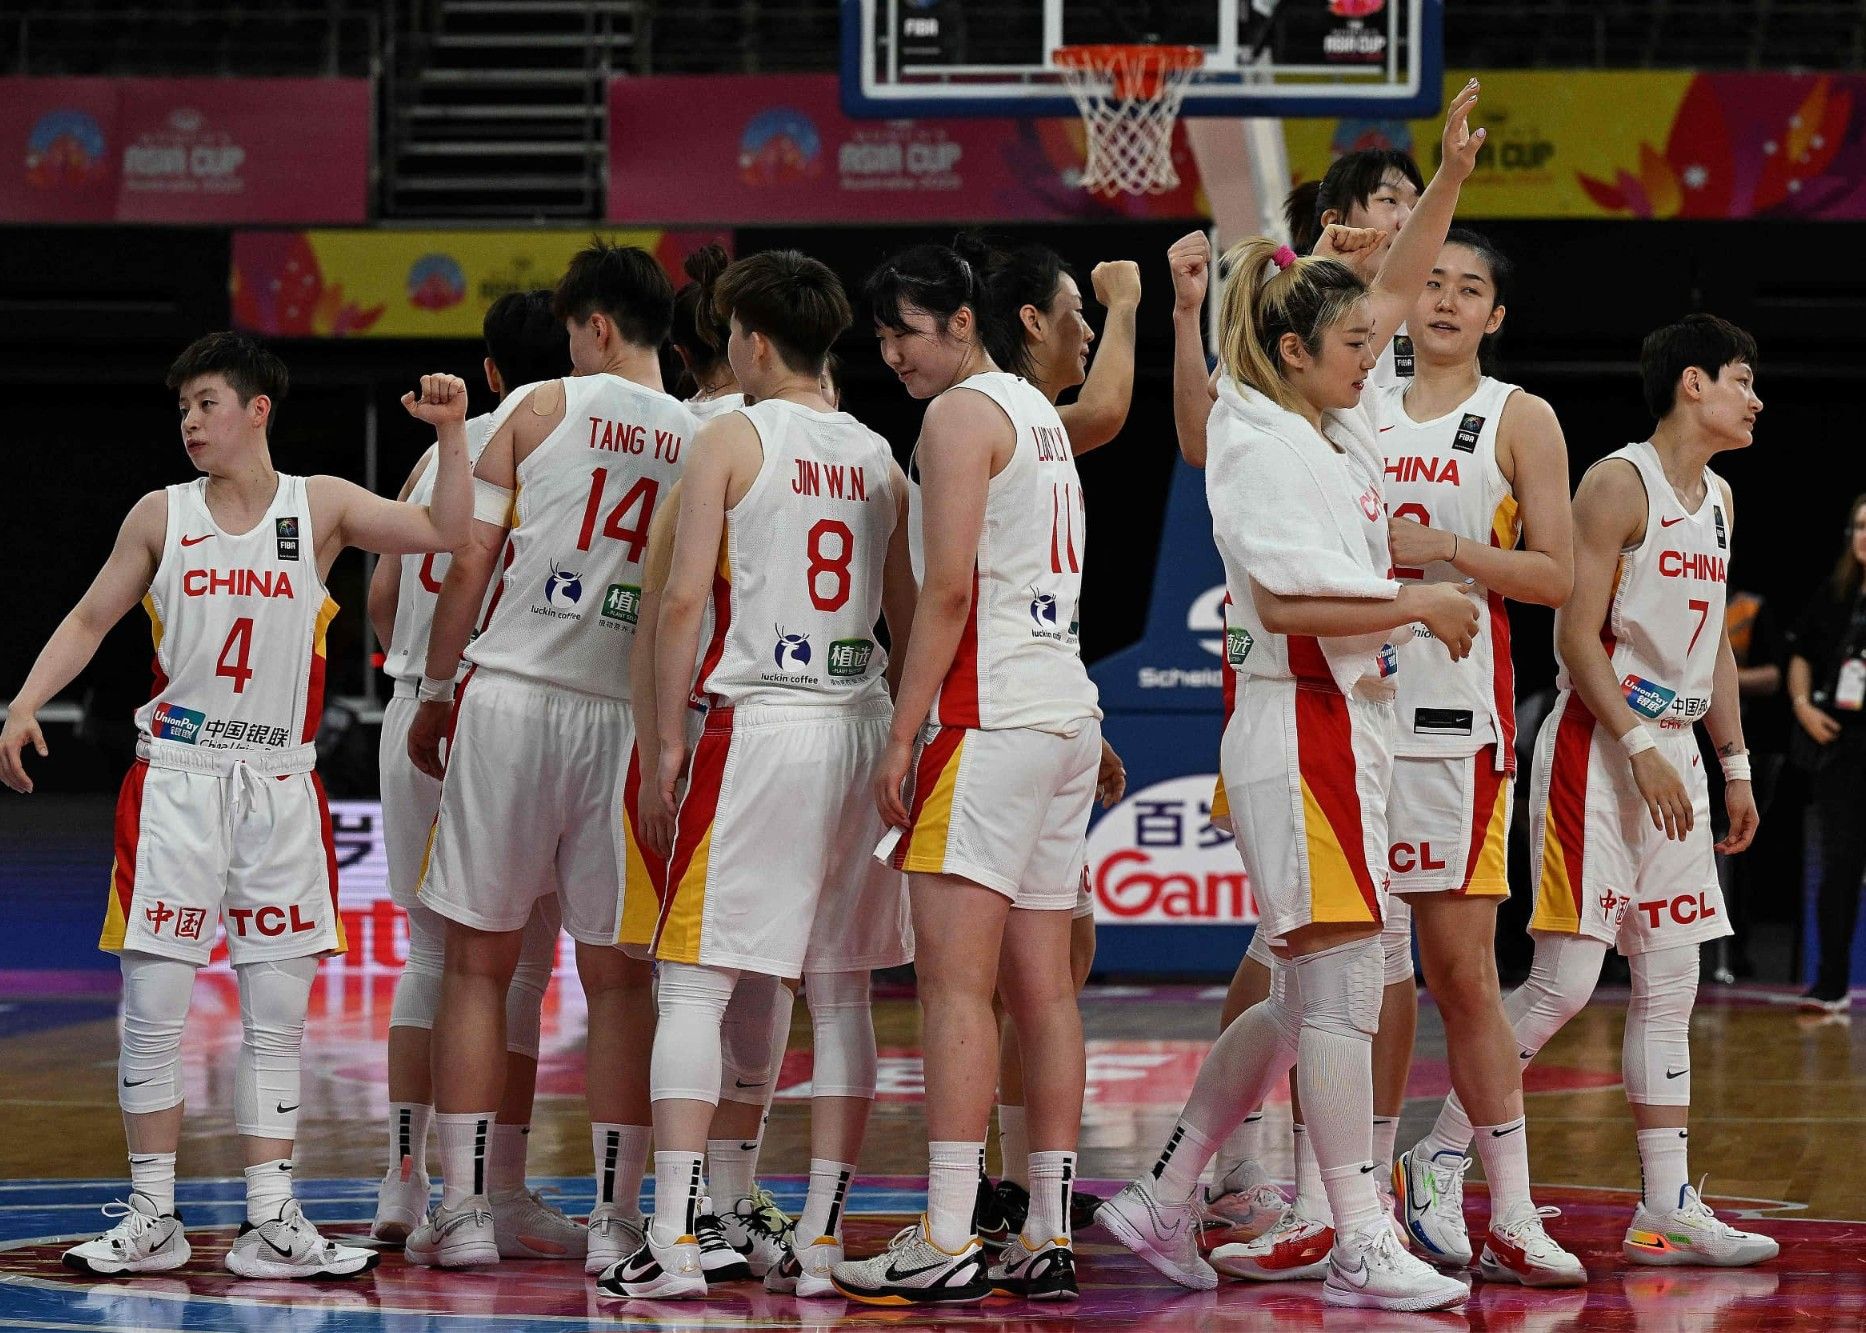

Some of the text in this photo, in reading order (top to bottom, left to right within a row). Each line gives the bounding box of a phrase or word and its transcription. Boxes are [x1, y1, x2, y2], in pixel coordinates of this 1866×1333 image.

[191, 145, 246, 177] CUP
[907, 142, 963, 175] CUP
[589, 416, 682, 464] TANG YU
[1458, 433, 1475, 443] FIBA
[791, 458, 870, 502] JIN W.N.
[1383, 456, 1460, 487] HINA
[576, 467, 660, 564] 14
[1051, 482, 1080, 574] 11
[280, 541, 297, 550] FIBA
[807, 518, 854, 613] 8
[1658, 550, 1727, 584] CHINA
[183, 568, 295, 599] CHINA
[530, 604, 582, 621] luckin coffee
[1686, 599, 1710, 661] 7
[215, 617, 254, 694] 4
[831, 645, 871, 667] 植选
[761, 673, 819, 685] luckin coffee
[1624, 679, 1669, 708] UnionPay
[154, 710, 199, 734] UnionPay
[205, 719, 290, 748] 中国银联
[1388, 841, 1446, 873] CL
[1095, 850, 1260, 917] Gan
[145, 900, 207, 940] 中国
[228, 904, 316, 937] TCL
[1638, 891, 1716, 929] TCL
